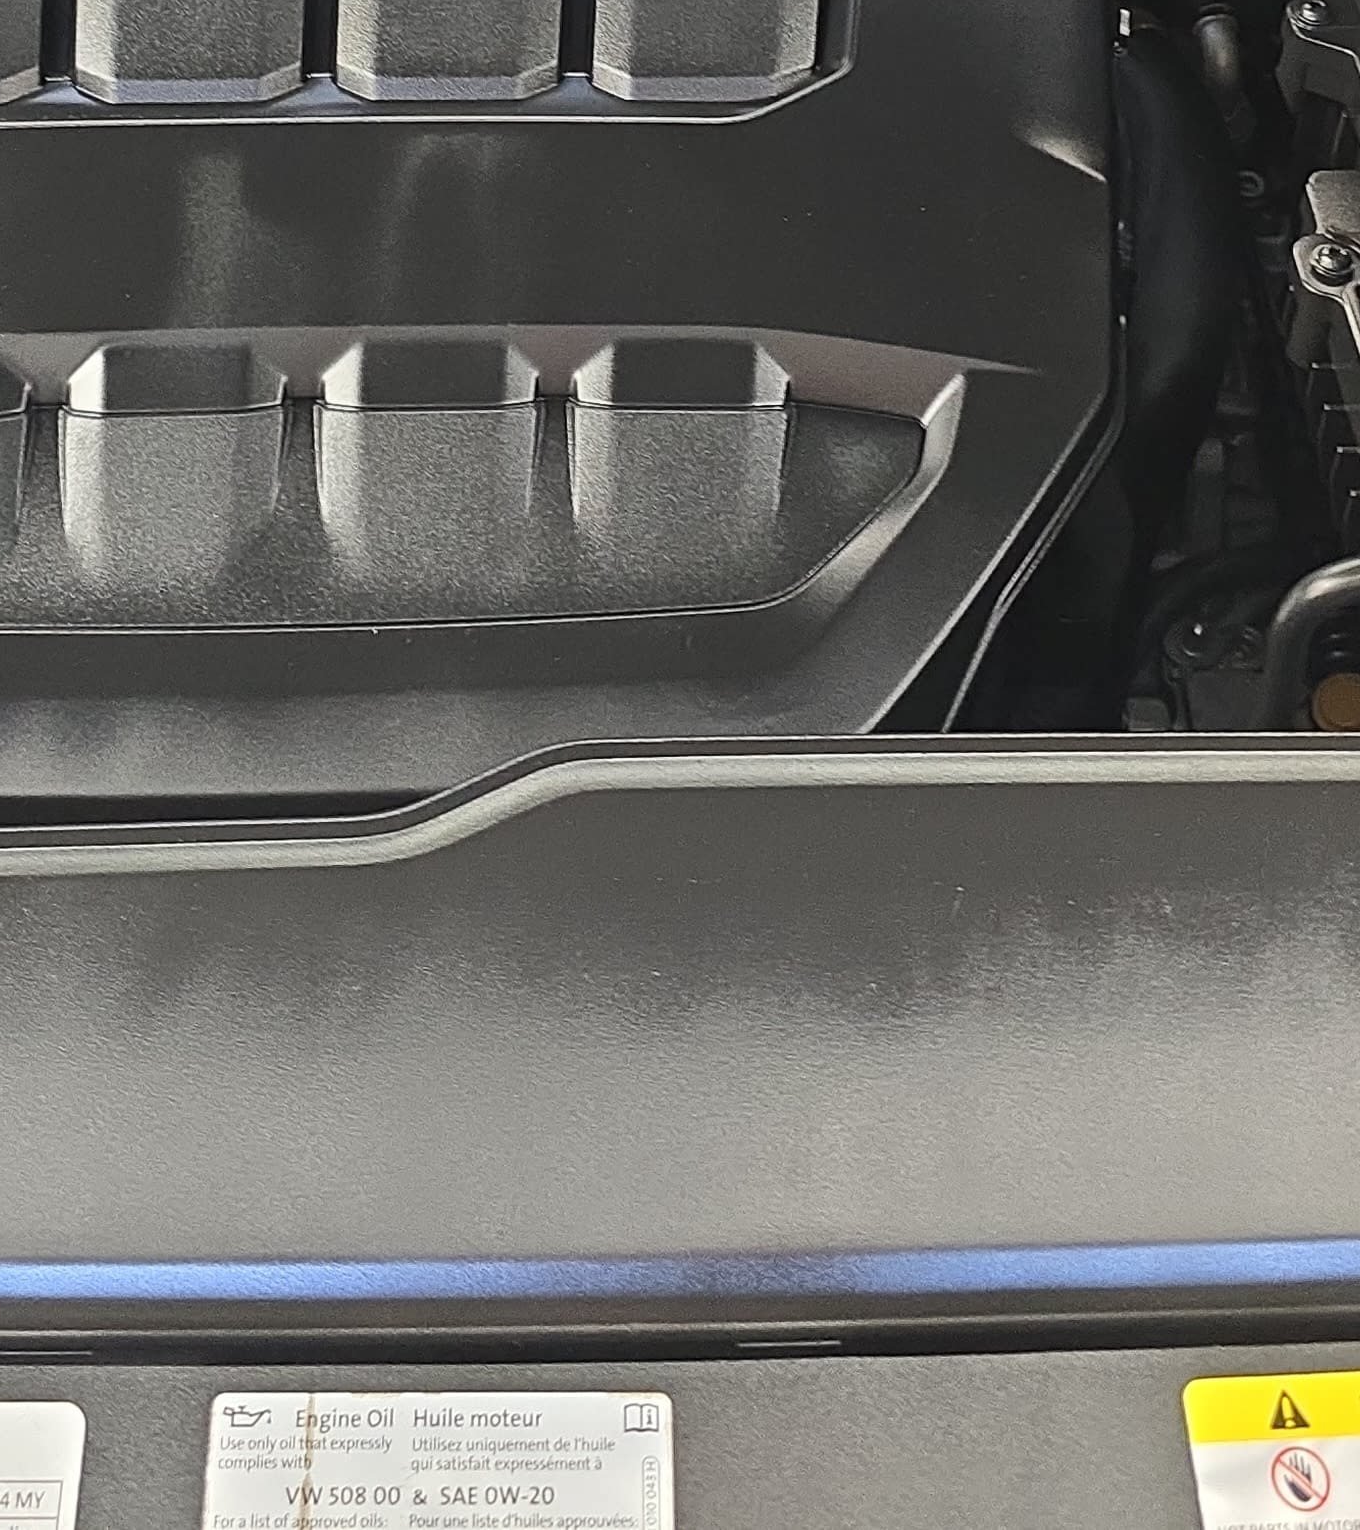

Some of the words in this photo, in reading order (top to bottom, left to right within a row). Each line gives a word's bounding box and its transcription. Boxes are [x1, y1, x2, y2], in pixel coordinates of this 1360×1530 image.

[295, 1408, 362, 1434] Engine
[367, 1408, 394, 1428] Oil
[413, 1408, 465, 1428] Huile
[470, 1410, 543, 1428] moteur
[220, 1436, 245, 1451] Use
[248, 1436, 276, 1455] only
[280, 1435, 296, 1450] oil
[300, 1435, 327, 1450] that
[330, 1435, 392, 1455] expressly
[412, 1436, 462, 1452] Utilisez
[466, 1438, 551, 1456] uniquement
[555, 1436, 572, 1452] de
[574, 1436, 616, 1452] l'huile
[217, 1456, 278, 1473] complies
[281, 1455, 313, 1471] with
[410, 1457, 434, 1473] qui
[436, 1456, 491, 1471] satisfait
[494, 1456, 590, 1474] expressément
[593, 1456, 603, 1471] à
[15, 1491, 46, 1509] MY
[285, 1485, 324, 1506] VW
[328, 1485, 367, 1506] 508
[372, 1485, 401, 1506] 00
[412, 1488, 428, 1506] &
[439, 1485, 479, 1506] SAE
[484, 1485, 556, 1506] 0W-20
[212, 1514, 235, 1530] For
[238, 1517, 246, 1530] a
[251, 1514, 272, 1530] list
[274, 1514, 289, 1530] of
[292, 1514, 357, 1530] approved
[360, 1514, 389, 1530] oils:
[409, 1513, 439, 1529] Pour
[443, 1517, 468, 1529] une
[471, 1513, 499, 1529] liste
[502, 1512, 554, 1529] d'huiles
